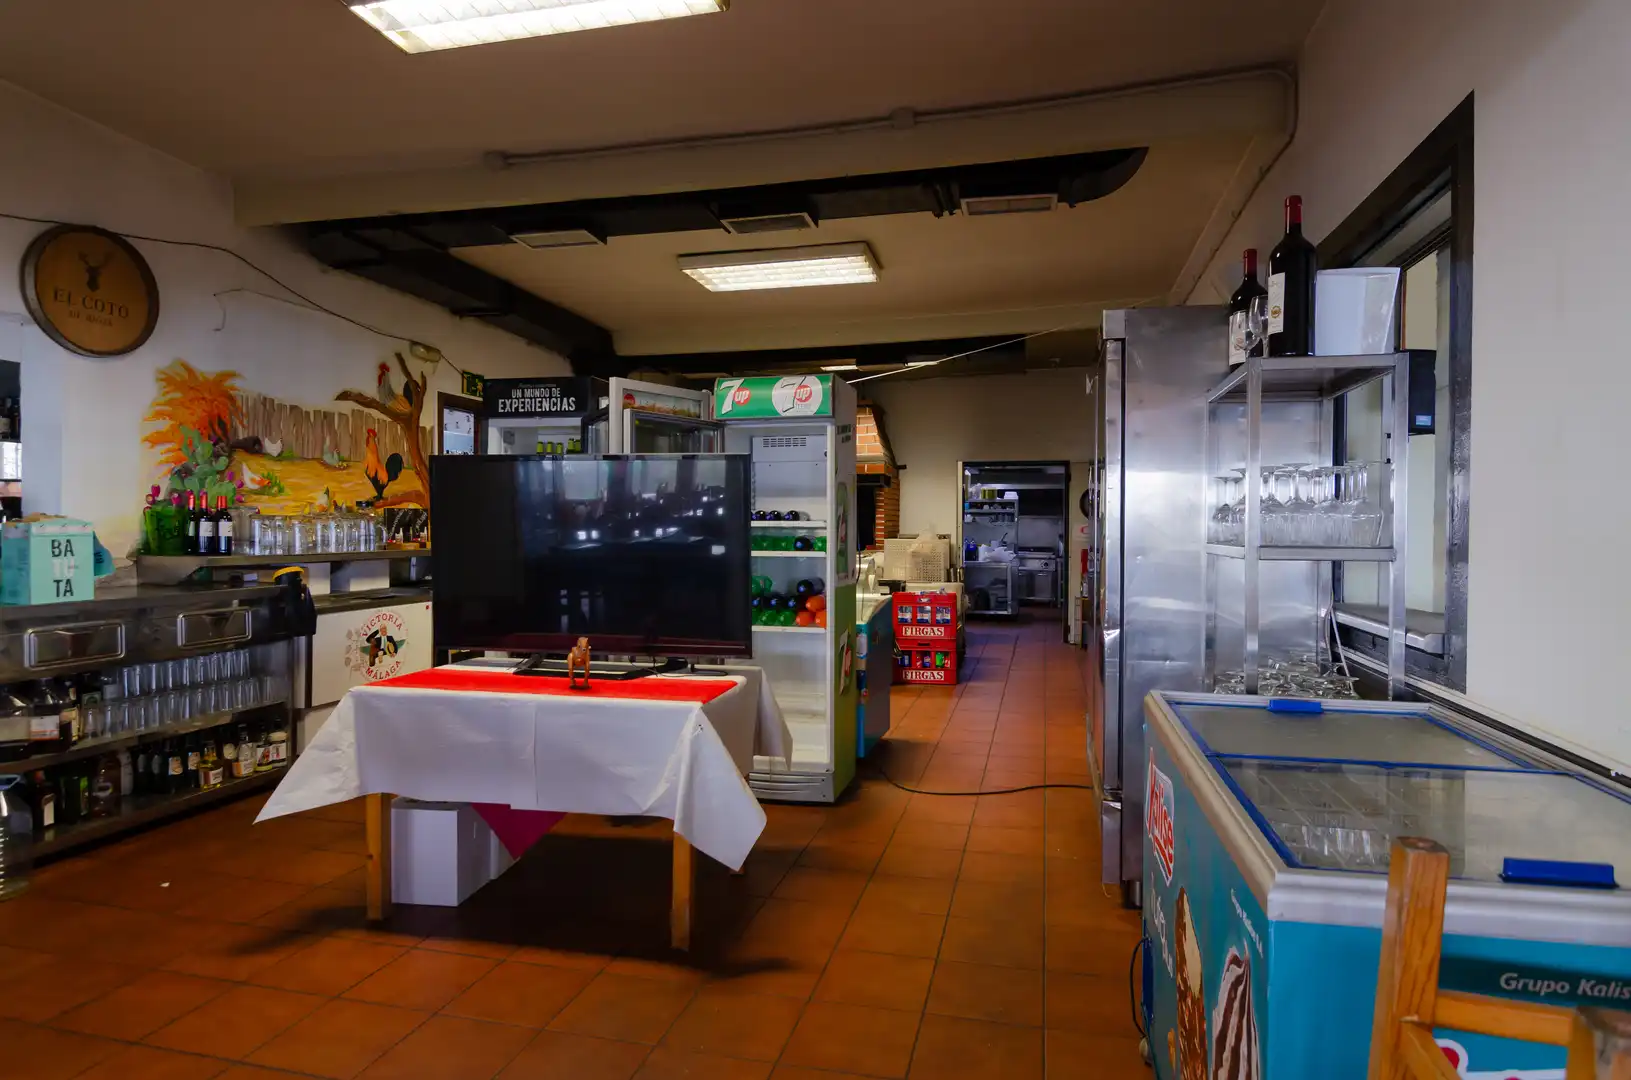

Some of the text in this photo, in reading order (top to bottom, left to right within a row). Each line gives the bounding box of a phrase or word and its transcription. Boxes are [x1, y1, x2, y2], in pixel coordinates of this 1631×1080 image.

[54, 286, 77, 308] EL
[82, 295, 129, 319] COTO
[512, 387, 561, 398] UN MUNDO DE
[498, 397, 576, 413] EXPERIENCIAS
[51, 538, 75, 557] BA
[53, 578, 74, 598] TA
[360, 613, 403, 637] VICTORIA
[903, 627, 944, 636] FIRGAS
[365, 660, 401, 679] MÁLAGA
[903, 671, 944, 680] FIRGAS
[1500, 972, 1570, 996] Grupo
